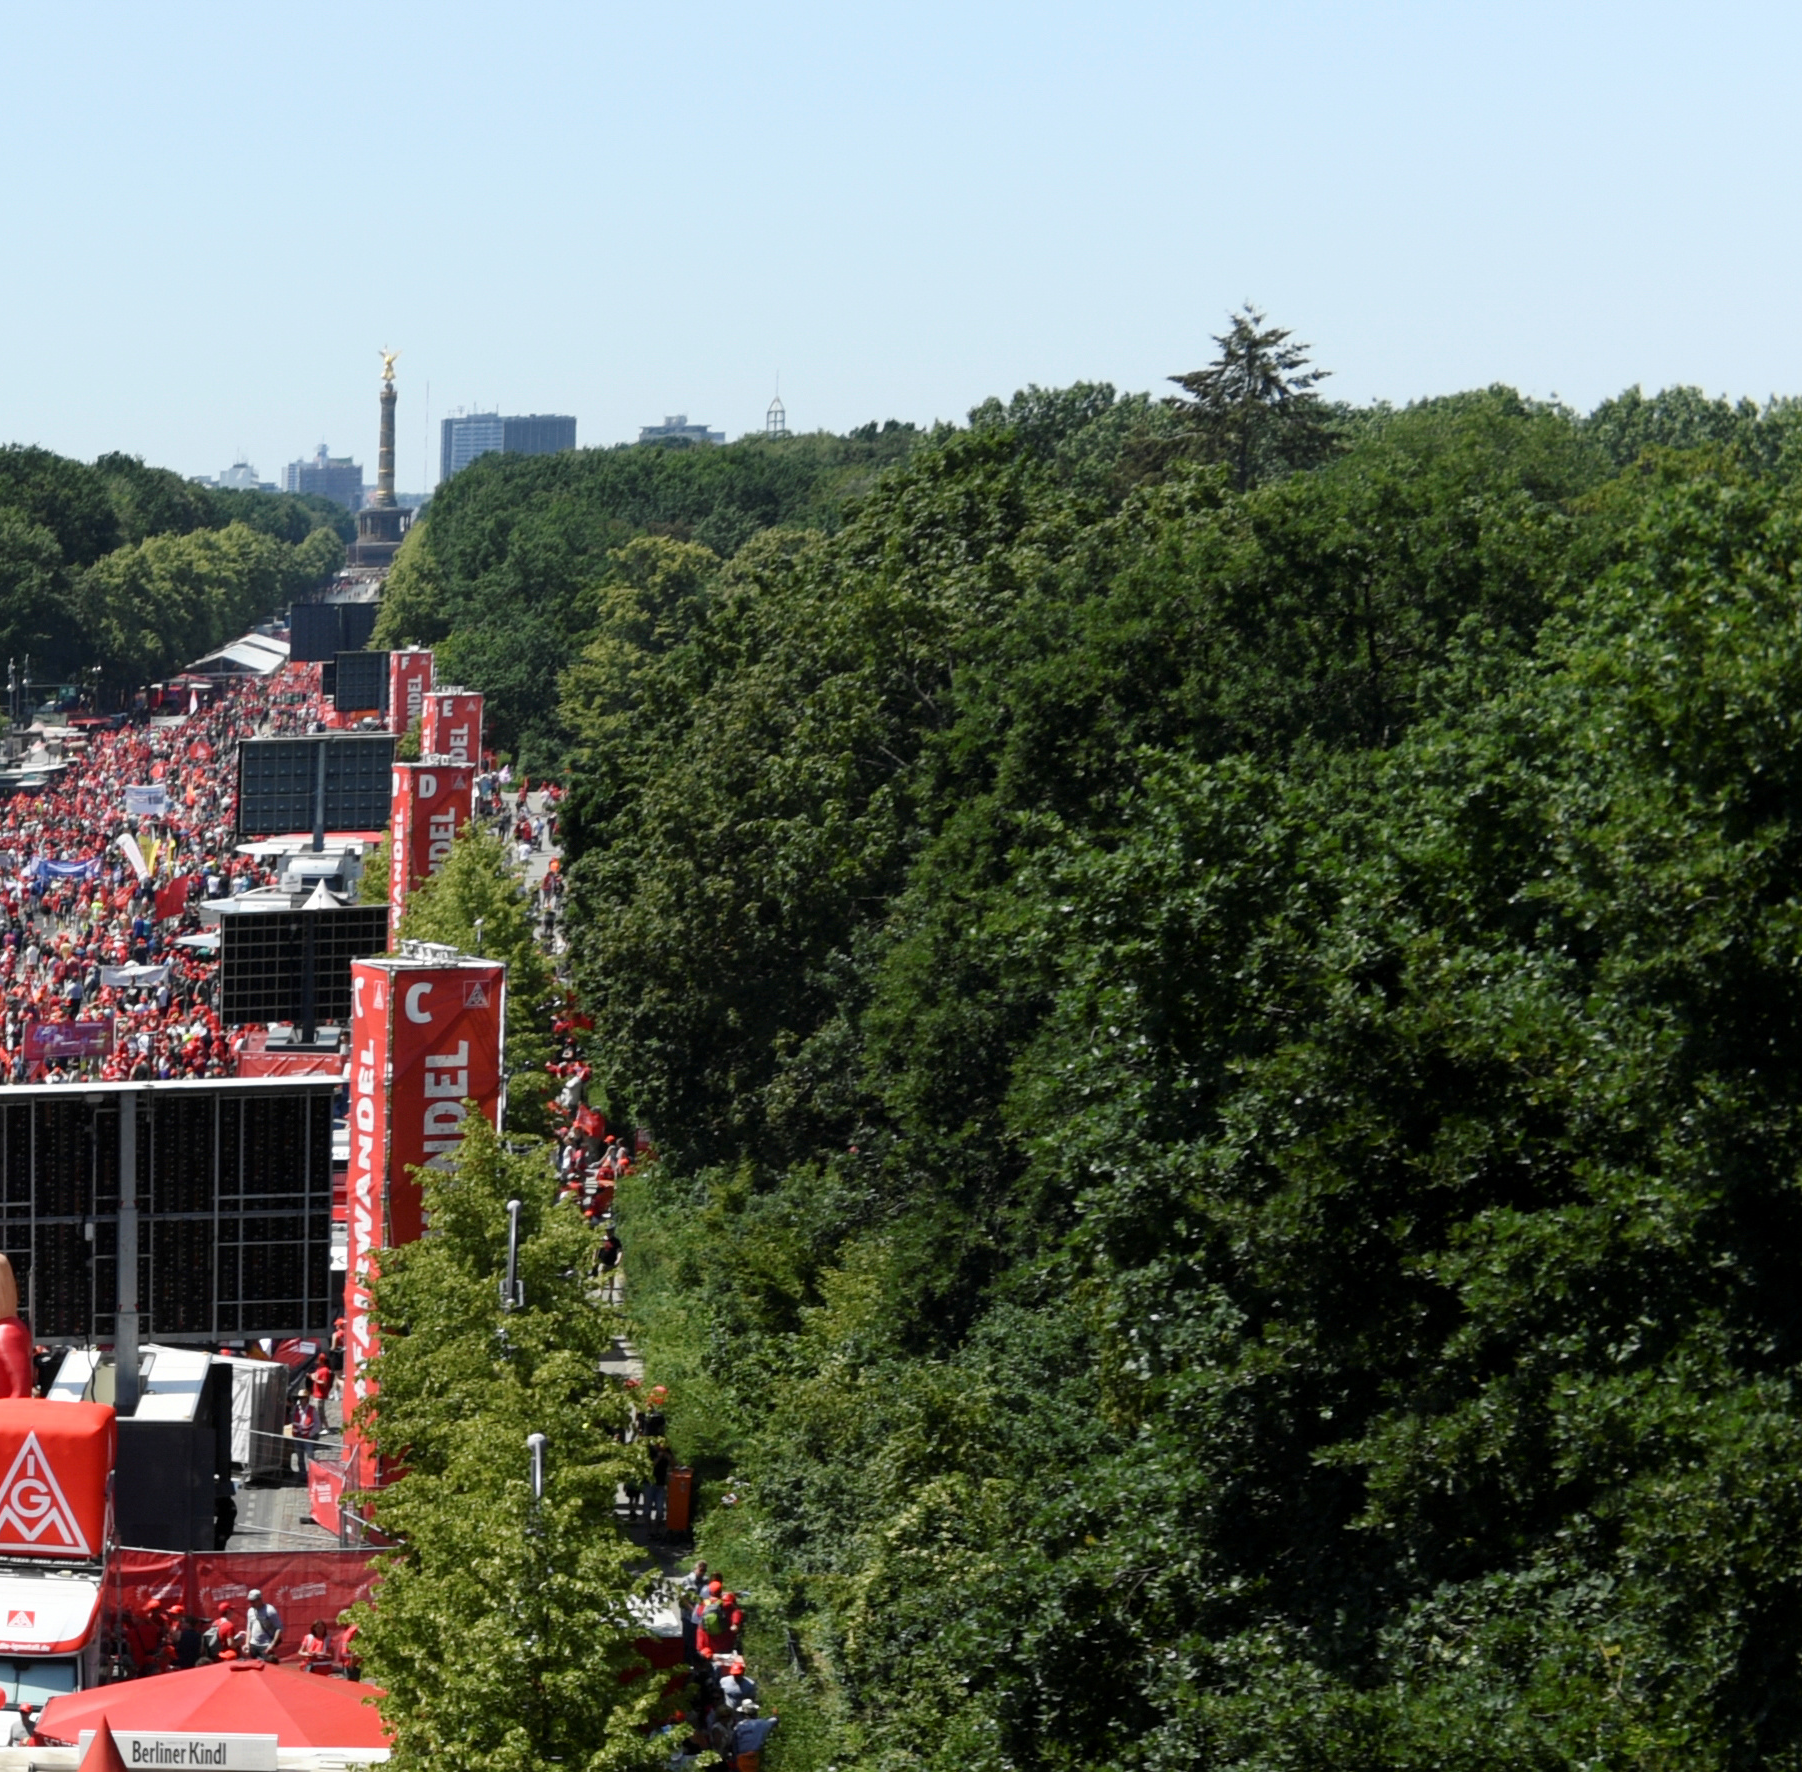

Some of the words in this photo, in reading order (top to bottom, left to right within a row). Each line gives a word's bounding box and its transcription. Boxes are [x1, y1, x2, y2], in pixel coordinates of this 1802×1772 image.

[442, 699, 453, 717] E
[419, 774, 437, 798] D
[405, 982, 434, 1024] C
[132, 1740, 187, 1766] Berliner
[189, 1741, 227, 1766] Kindl
